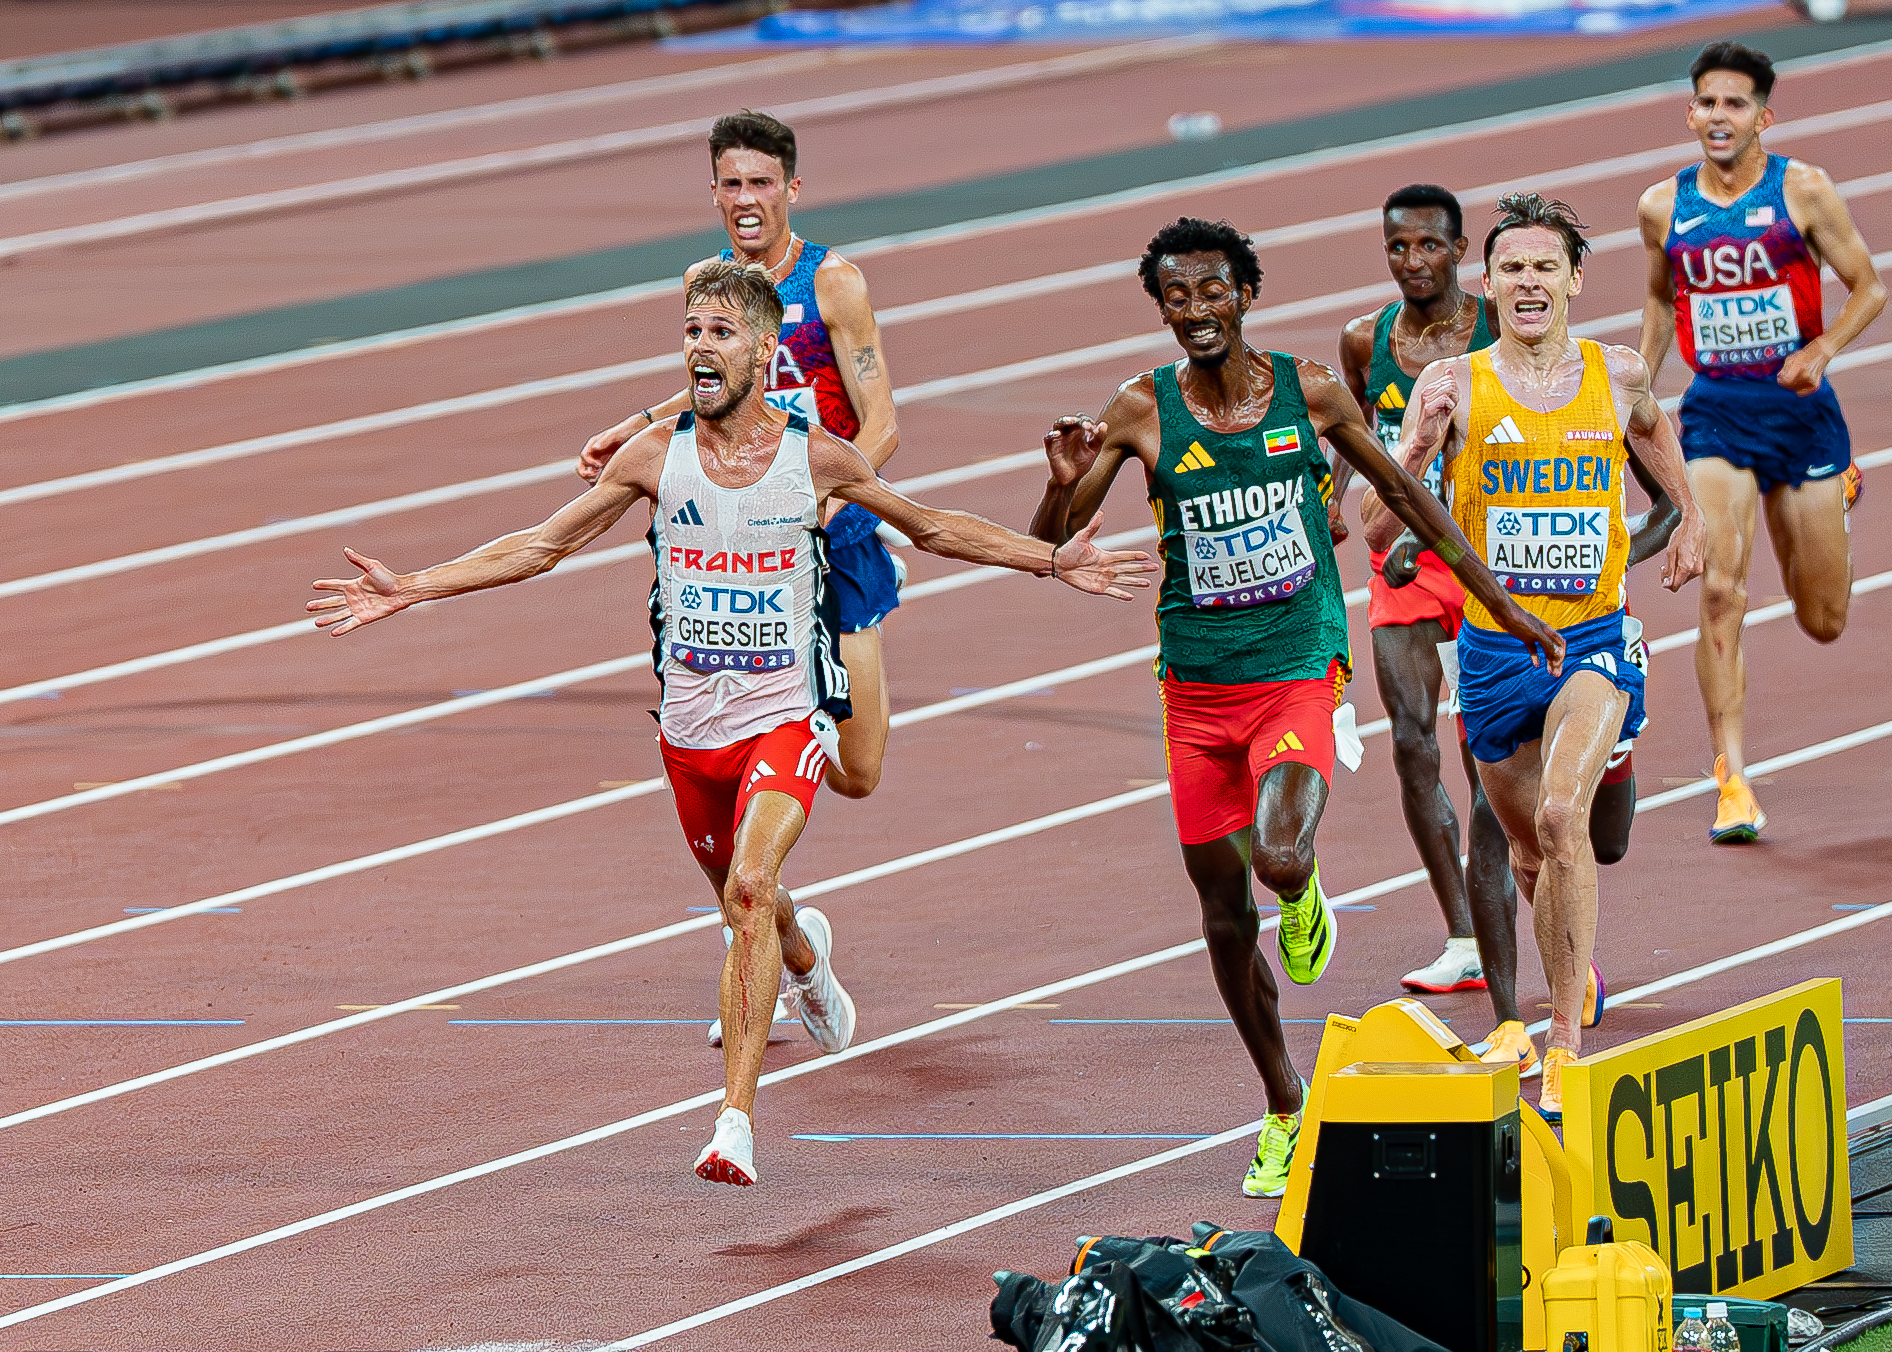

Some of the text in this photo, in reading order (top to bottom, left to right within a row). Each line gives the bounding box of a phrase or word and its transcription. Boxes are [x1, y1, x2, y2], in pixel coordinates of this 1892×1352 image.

[1682, 241, 1779, 289] USA
[1713, 289, 1784, 317] TDK
[1700, 317, 1790, 346] FISHER
[1566, 430, 1614, 441] BAUHAUS
[1482, 455, 1611, 495] SWEDEN
[1178, 474, 1304, 530] ETHIOPIA
[1213, 512, 1294, 557] TDK
[1522, 512, 1602, 536] TDK
[670, 546, 797, 573] FRANCE
[1194, 539, 1308, 590] KEJELCHA
[1495, 543, 1604, 569] ALMGREN
[702, 587, 784, 614] TDK
[678, 616, 788, 647] GRESSIER
[1607, 1008, 1834, 1294] SEIKO
